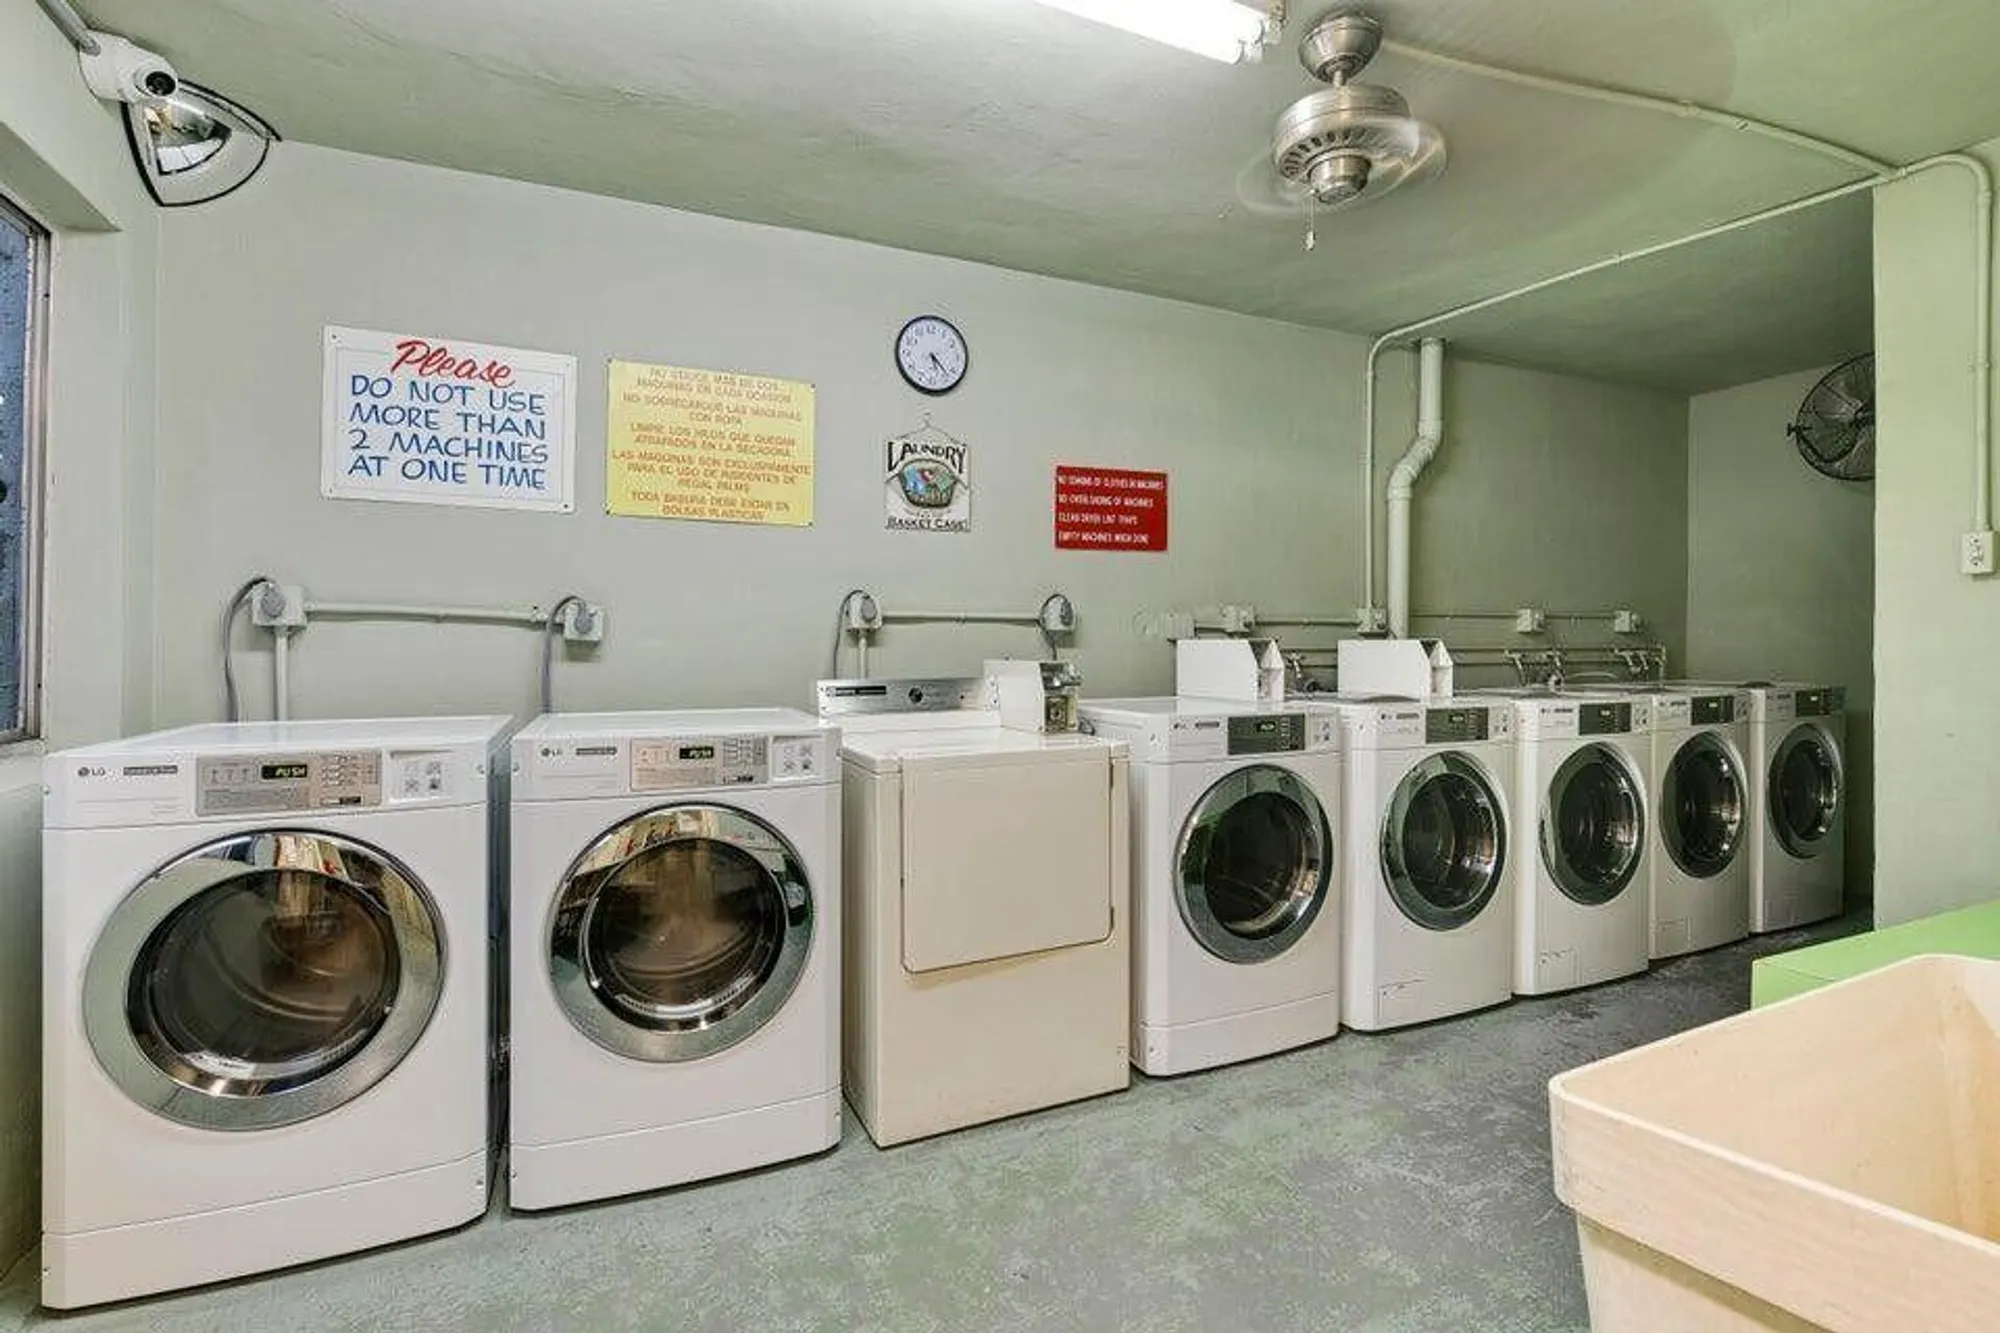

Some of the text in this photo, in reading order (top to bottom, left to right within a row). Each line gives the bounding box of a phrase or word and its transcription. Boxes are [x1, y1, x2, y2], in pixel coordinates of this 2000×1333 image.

[390, 340, 515, 388] Please
[351, 375, 545, 415] DO NOT USE
[350, 402, 545, 440] MORE THAN
[348, 429, 548, 464] 2 MACHINES
[887, 441, 968, 475] LAUNDRY
[348, 455, 545, 490] AT ONE TIME
[886, 516, 932, 530] BASKET
[91, 767, 106, 777] LG
